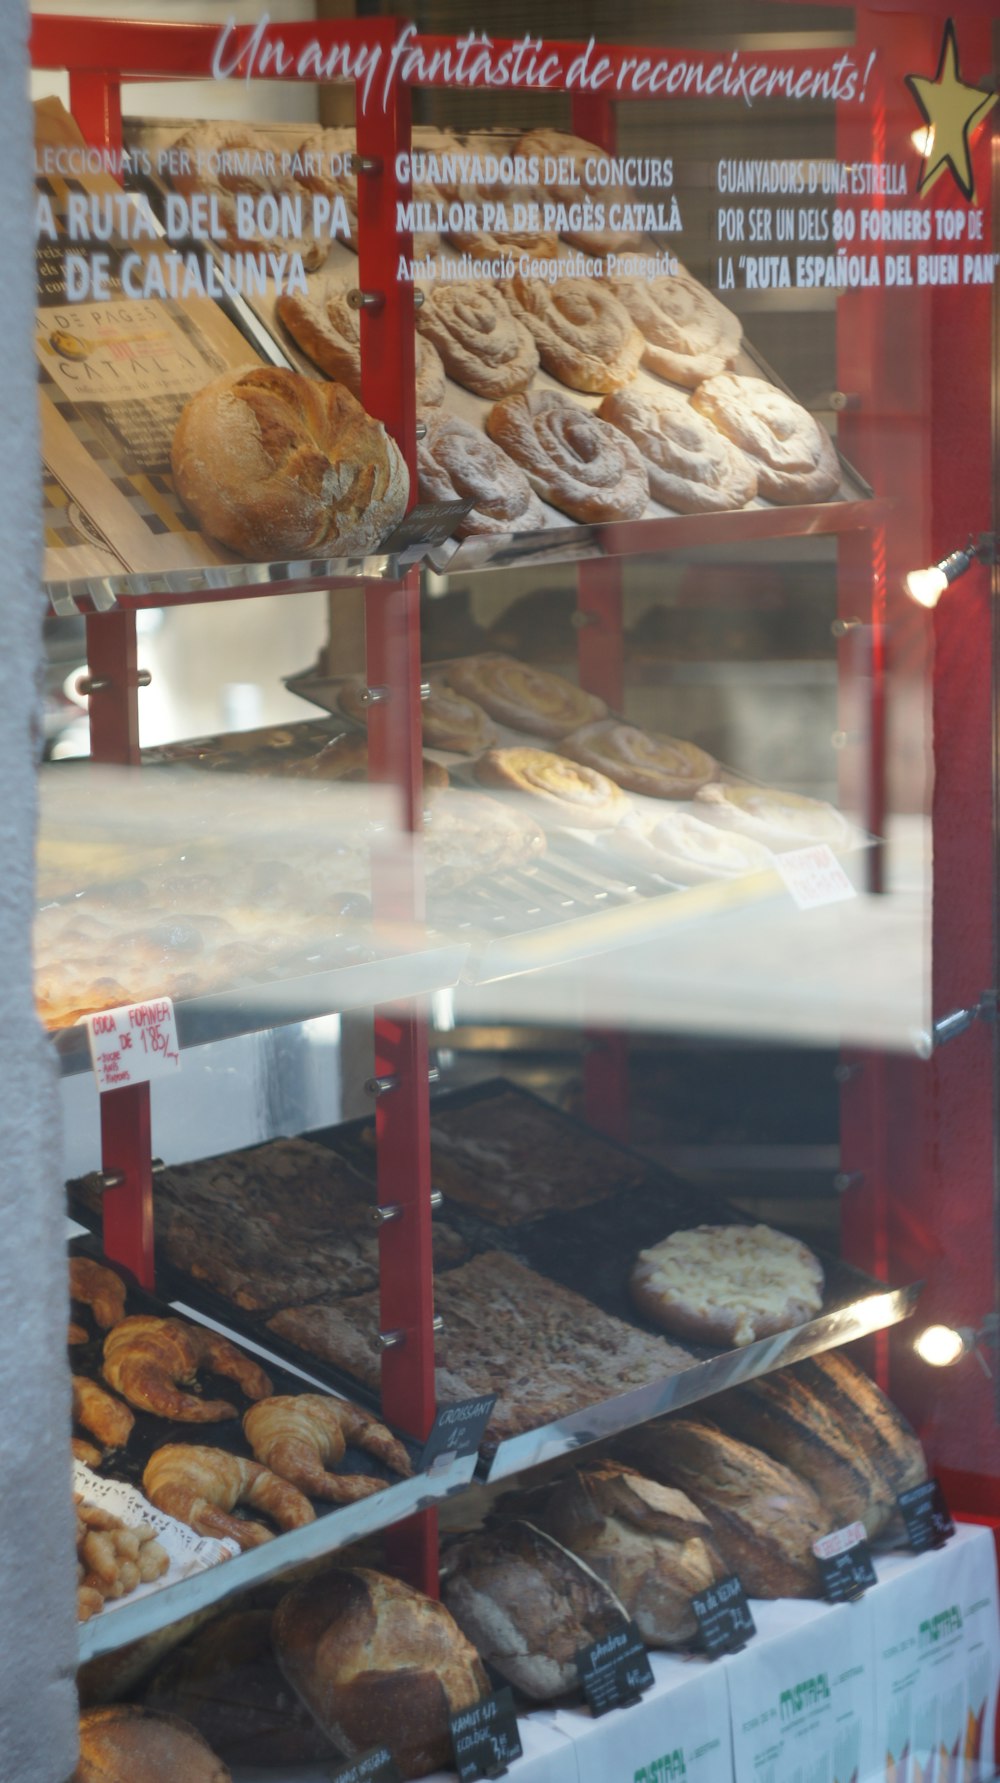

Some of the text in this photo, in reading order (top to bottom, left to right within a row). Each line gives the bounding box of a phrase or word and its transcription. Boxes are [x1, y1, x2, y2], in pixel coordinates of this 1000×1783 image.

[212, 12, 876, 116] Un any fantàstic de reconeixements!
[157, 151, 191, 176] PER
[198, 150, 277, 177] FORMAR
[281, 151, 324, 177] PART
[330, 153, 352, 177] DE
[395, 153, 673, 187] GUANYADORS DEL CONCURS
[717, 159, 908, 195] GUANYADORS D'UNA ESTRELLA
[67, 193, 157, 240] RUTA
[165, 194, 227, 241] DEL
[235, 193, 301, 241] BON
[312, 195, 351, 240] PA
[396, 195, 682, 232] MILLOR PA DE PAGÈS CATALÀ
[718, 208, 984, 241] POR SER UN DELS 80 FORNERS TOP DE
[64, 251, 309, 301] DE CATALUNYA
[396, 251, 679, 285] Amb Indicació Geogràfica Protegida
[718, 257, 735, 289] LA
[738, 256, 791, 289] "RUTA
[796, 248, 880, 288] ESPAÑOLA
[885, 256, 913, 287] DEL
[917, 255, 959, 286] BUEN
[54, 314, 85, 330] DE
[92, 1015, 116, 1036] COCA
[119, 1033, 132, 1050] DE
